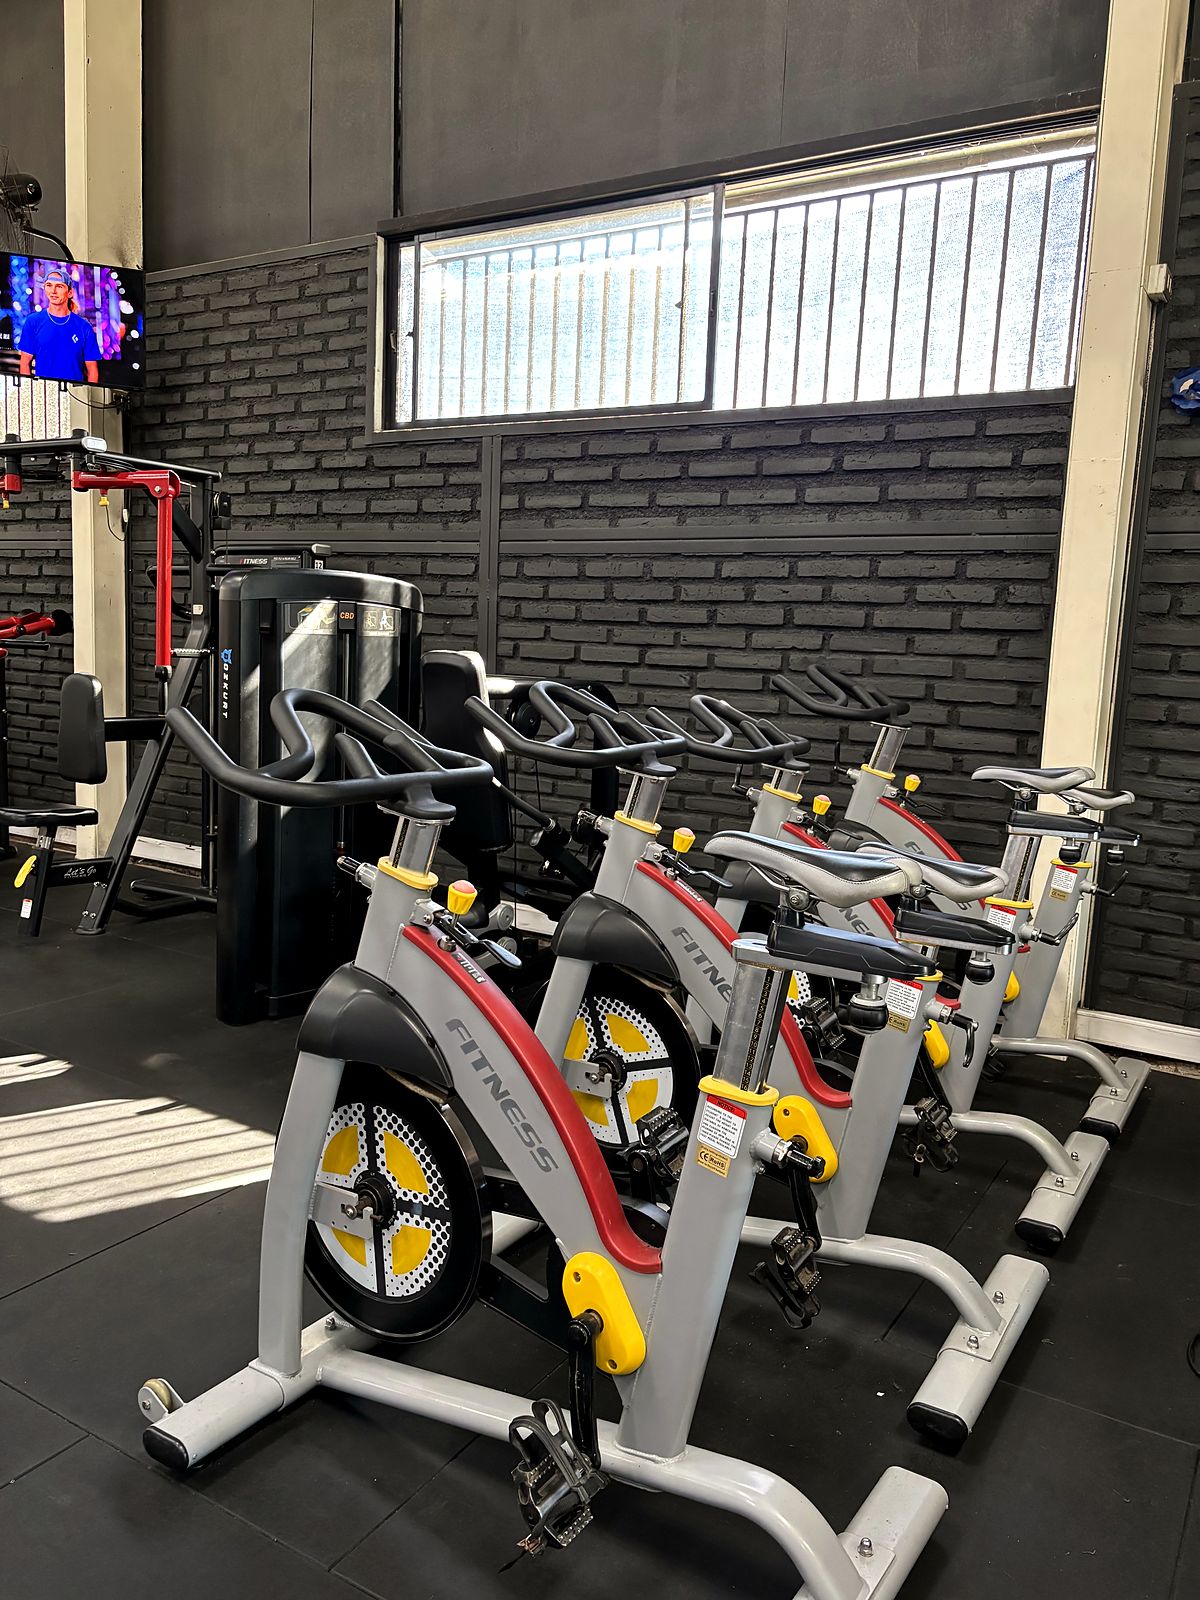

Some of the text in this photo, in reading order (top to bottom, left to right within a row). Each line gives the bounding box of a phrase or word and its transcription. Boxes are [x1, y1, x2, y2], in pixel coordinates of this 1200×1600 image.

[672, 926, 732, 1002] FITNE
[446, 1018, 559, 1173] FITNESS
[700, 1151, 709, 1162] CE
